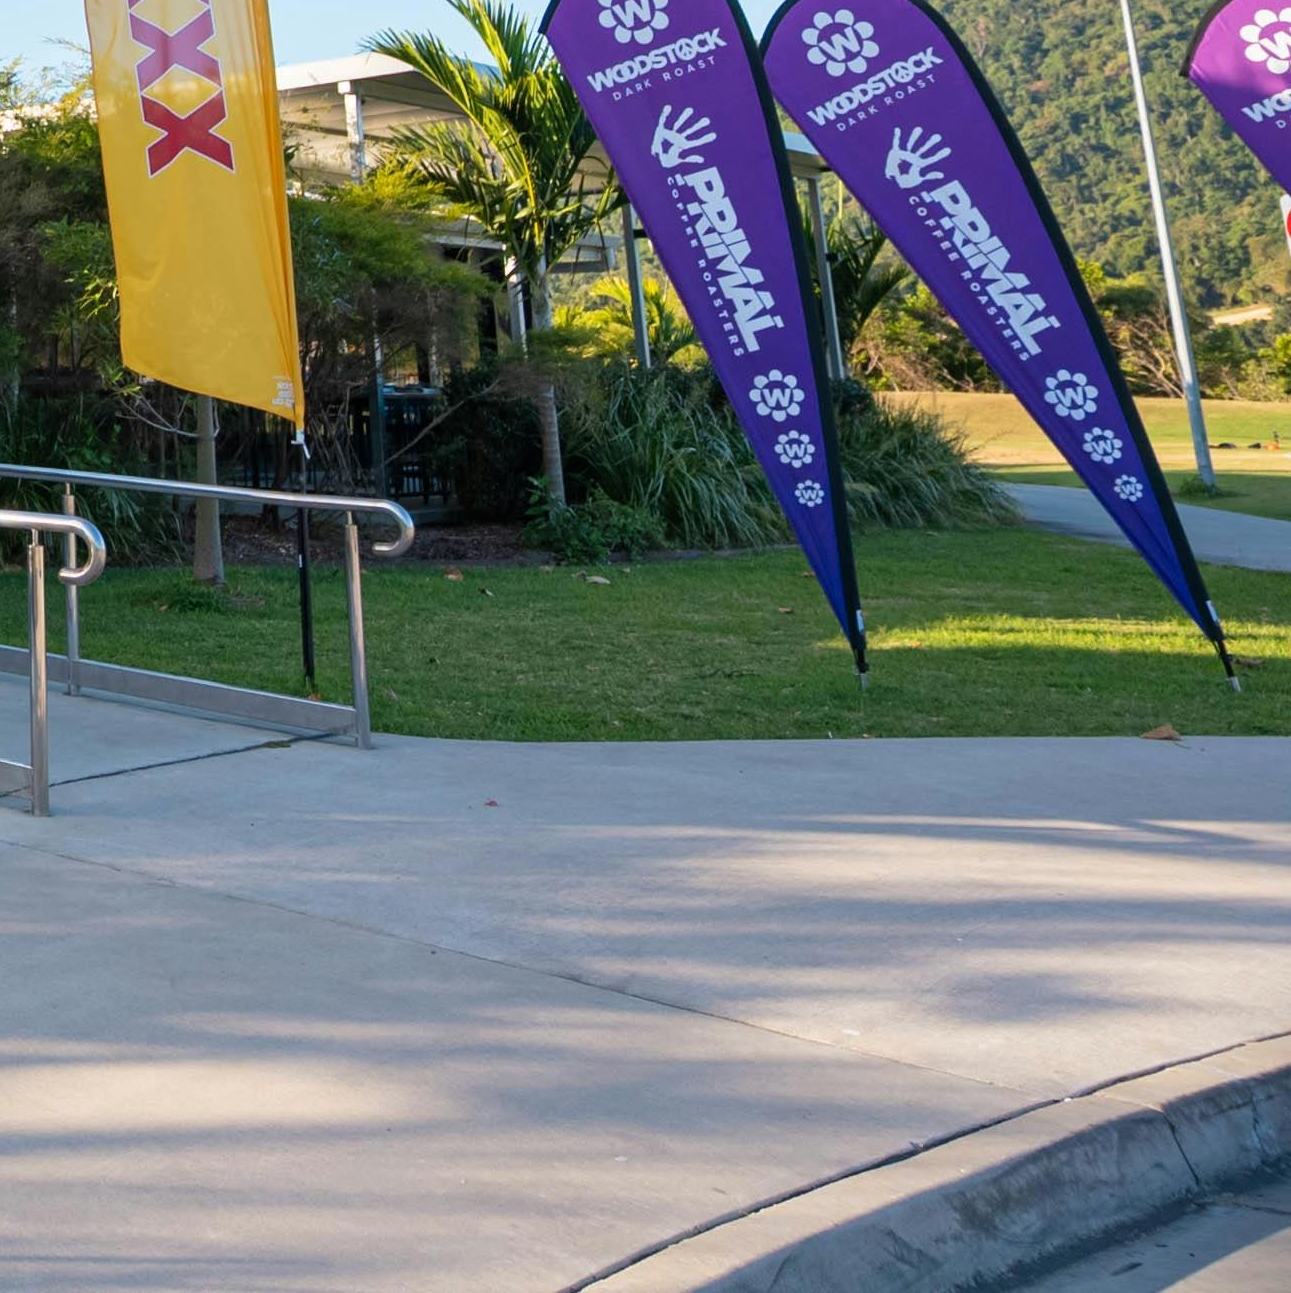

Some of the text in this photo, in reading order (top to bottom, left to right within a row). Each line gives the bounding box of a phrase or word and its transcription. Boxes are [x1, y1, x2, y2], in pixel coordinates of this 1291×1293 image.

[587, 27, 728, 92] WOODSTOCK
[819, 26, 860, 61] W
[612, 56, 715, 101] DARK ROAST
[806, 46, 944, 126] WOODSTOCK
[836, 74, 935, 131] DARK ROAST
[667, 176, 744, 357] COFFEE ROASTERS
[675, 166, 784, 352] PRIMAL
[909, 196, 1030, 361] COFFEE ROASTERS
[921, 180, 1061, 356] PRIMAL
[762, 388, 791, 407] W
[1055, 387, 1084, 407] W
[784, 444, 806, 458] W
[1091, 440, 1112, 454] W
